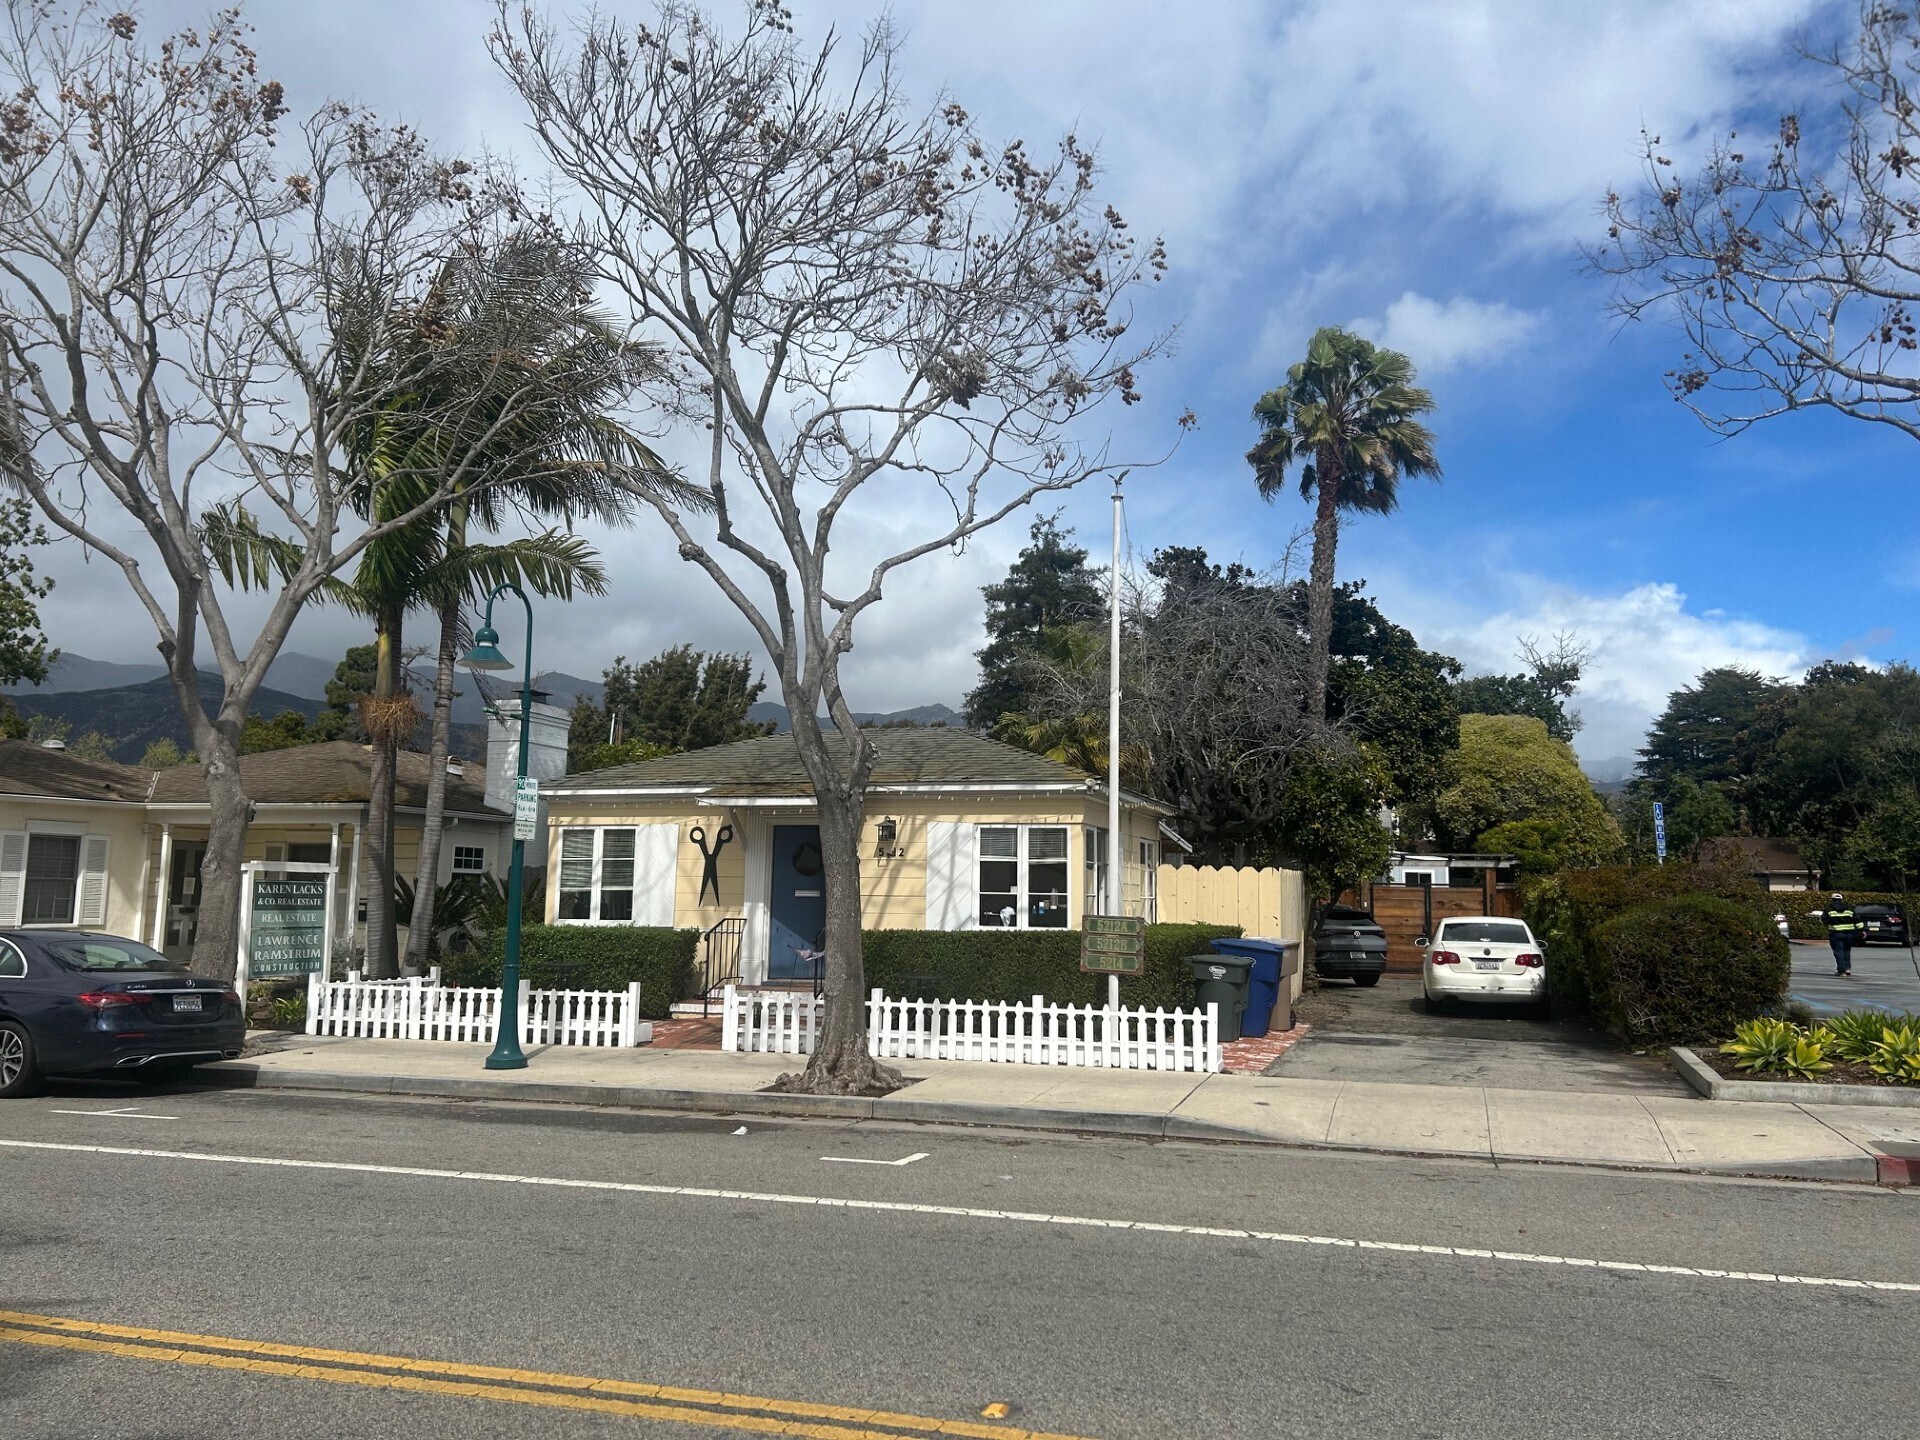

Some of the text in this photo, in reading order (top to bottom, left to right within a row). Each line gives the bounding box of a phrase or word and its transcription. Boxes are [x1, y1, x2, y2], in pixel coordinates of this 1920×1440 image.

[518, 793, 536, 803] PARKING
[257, 884, 323, 895] KAREN LACKS
[297, 898, 322, 906] ESTATE
[261, 913, 317, 923] REAL ESTATE
[1097, 920, 1128, 932] 5212A
[257, 934, 319, 946] LAWRENCE
[1096, 938, 1127, 951] 5212B
[254, 949, 321, 961] RAMSTRUM
[254, 962, 320, 973] CONSTRUCTION
[1099, 957, 1123, 969] 5214
